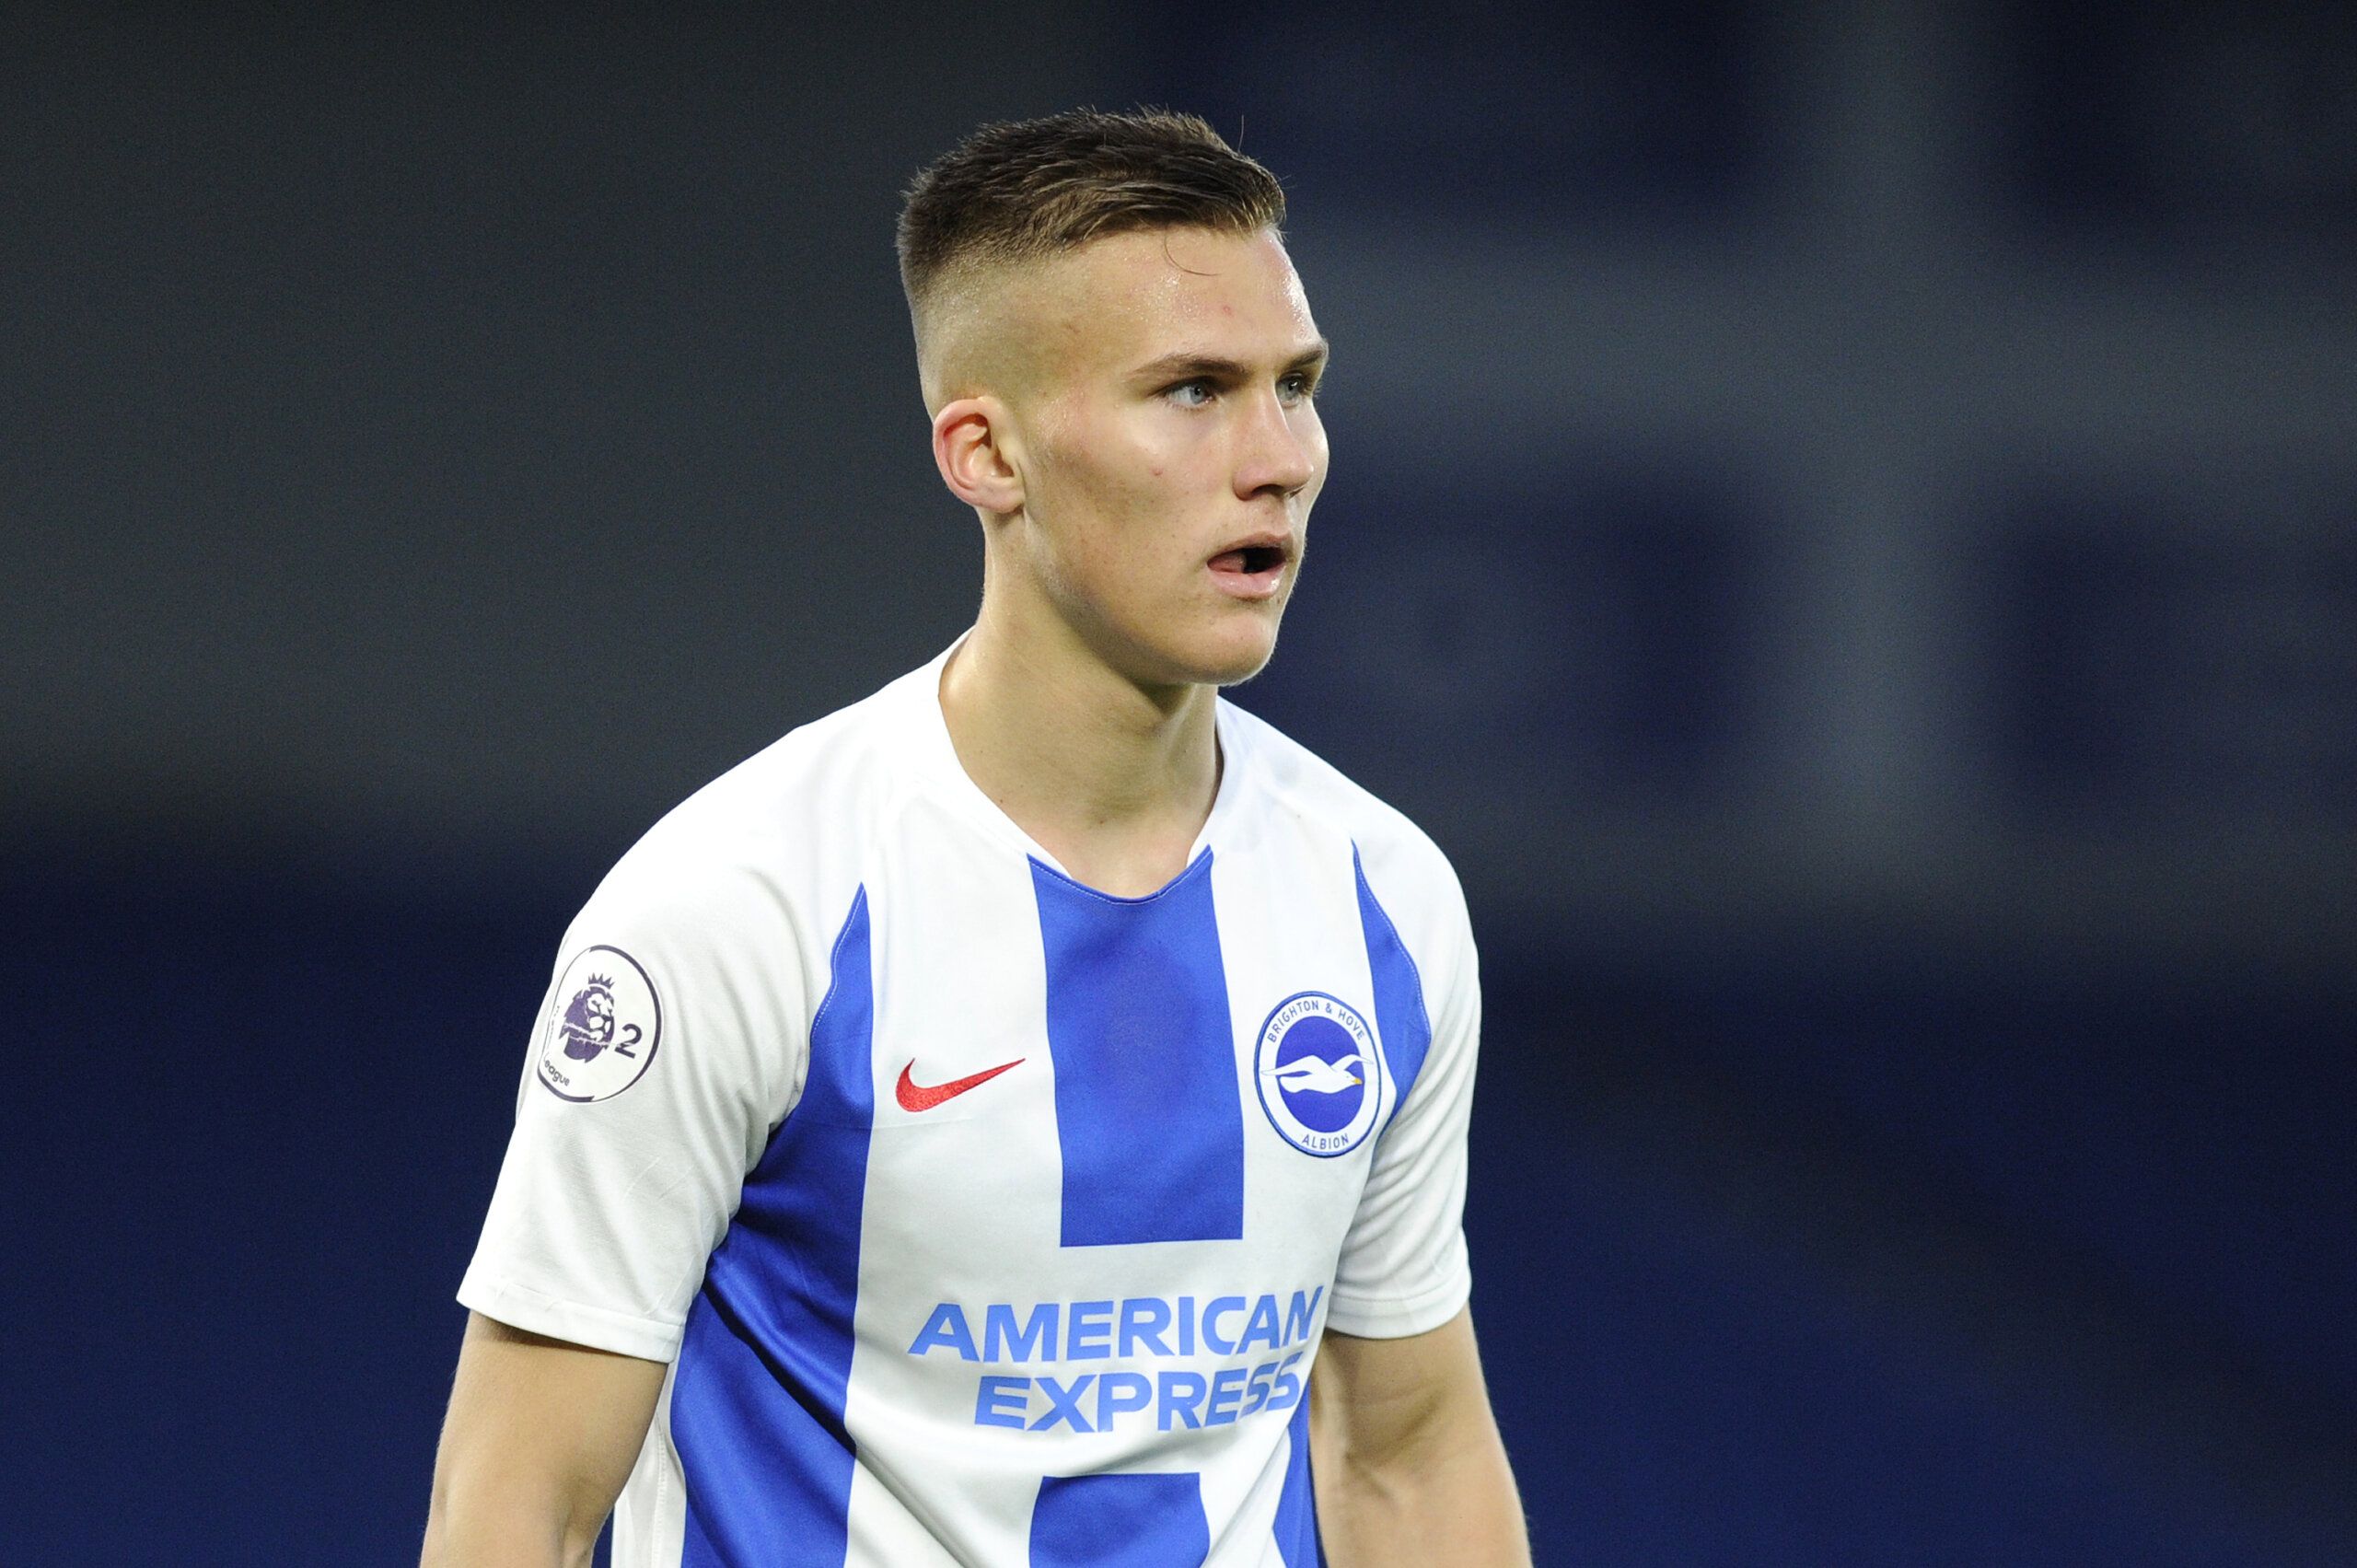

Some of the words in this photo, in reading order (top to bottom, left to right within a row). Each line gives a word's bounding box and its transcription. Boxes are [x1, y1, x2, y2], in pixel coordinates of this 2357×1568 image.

[615, 1023, 642, 1059] 2
[1267, 1000, 1319, 1042] BRIGHTON
[1326, 1003, 1332, 1014] &
[1338, 1009, 1364, 1040] HOVE
[1302, 1133, 1350, 1150] ALBION
[907, 1285, 1324, 1363] AMERICAN
[974, 1352, 1304, 1433] EXPRESS
